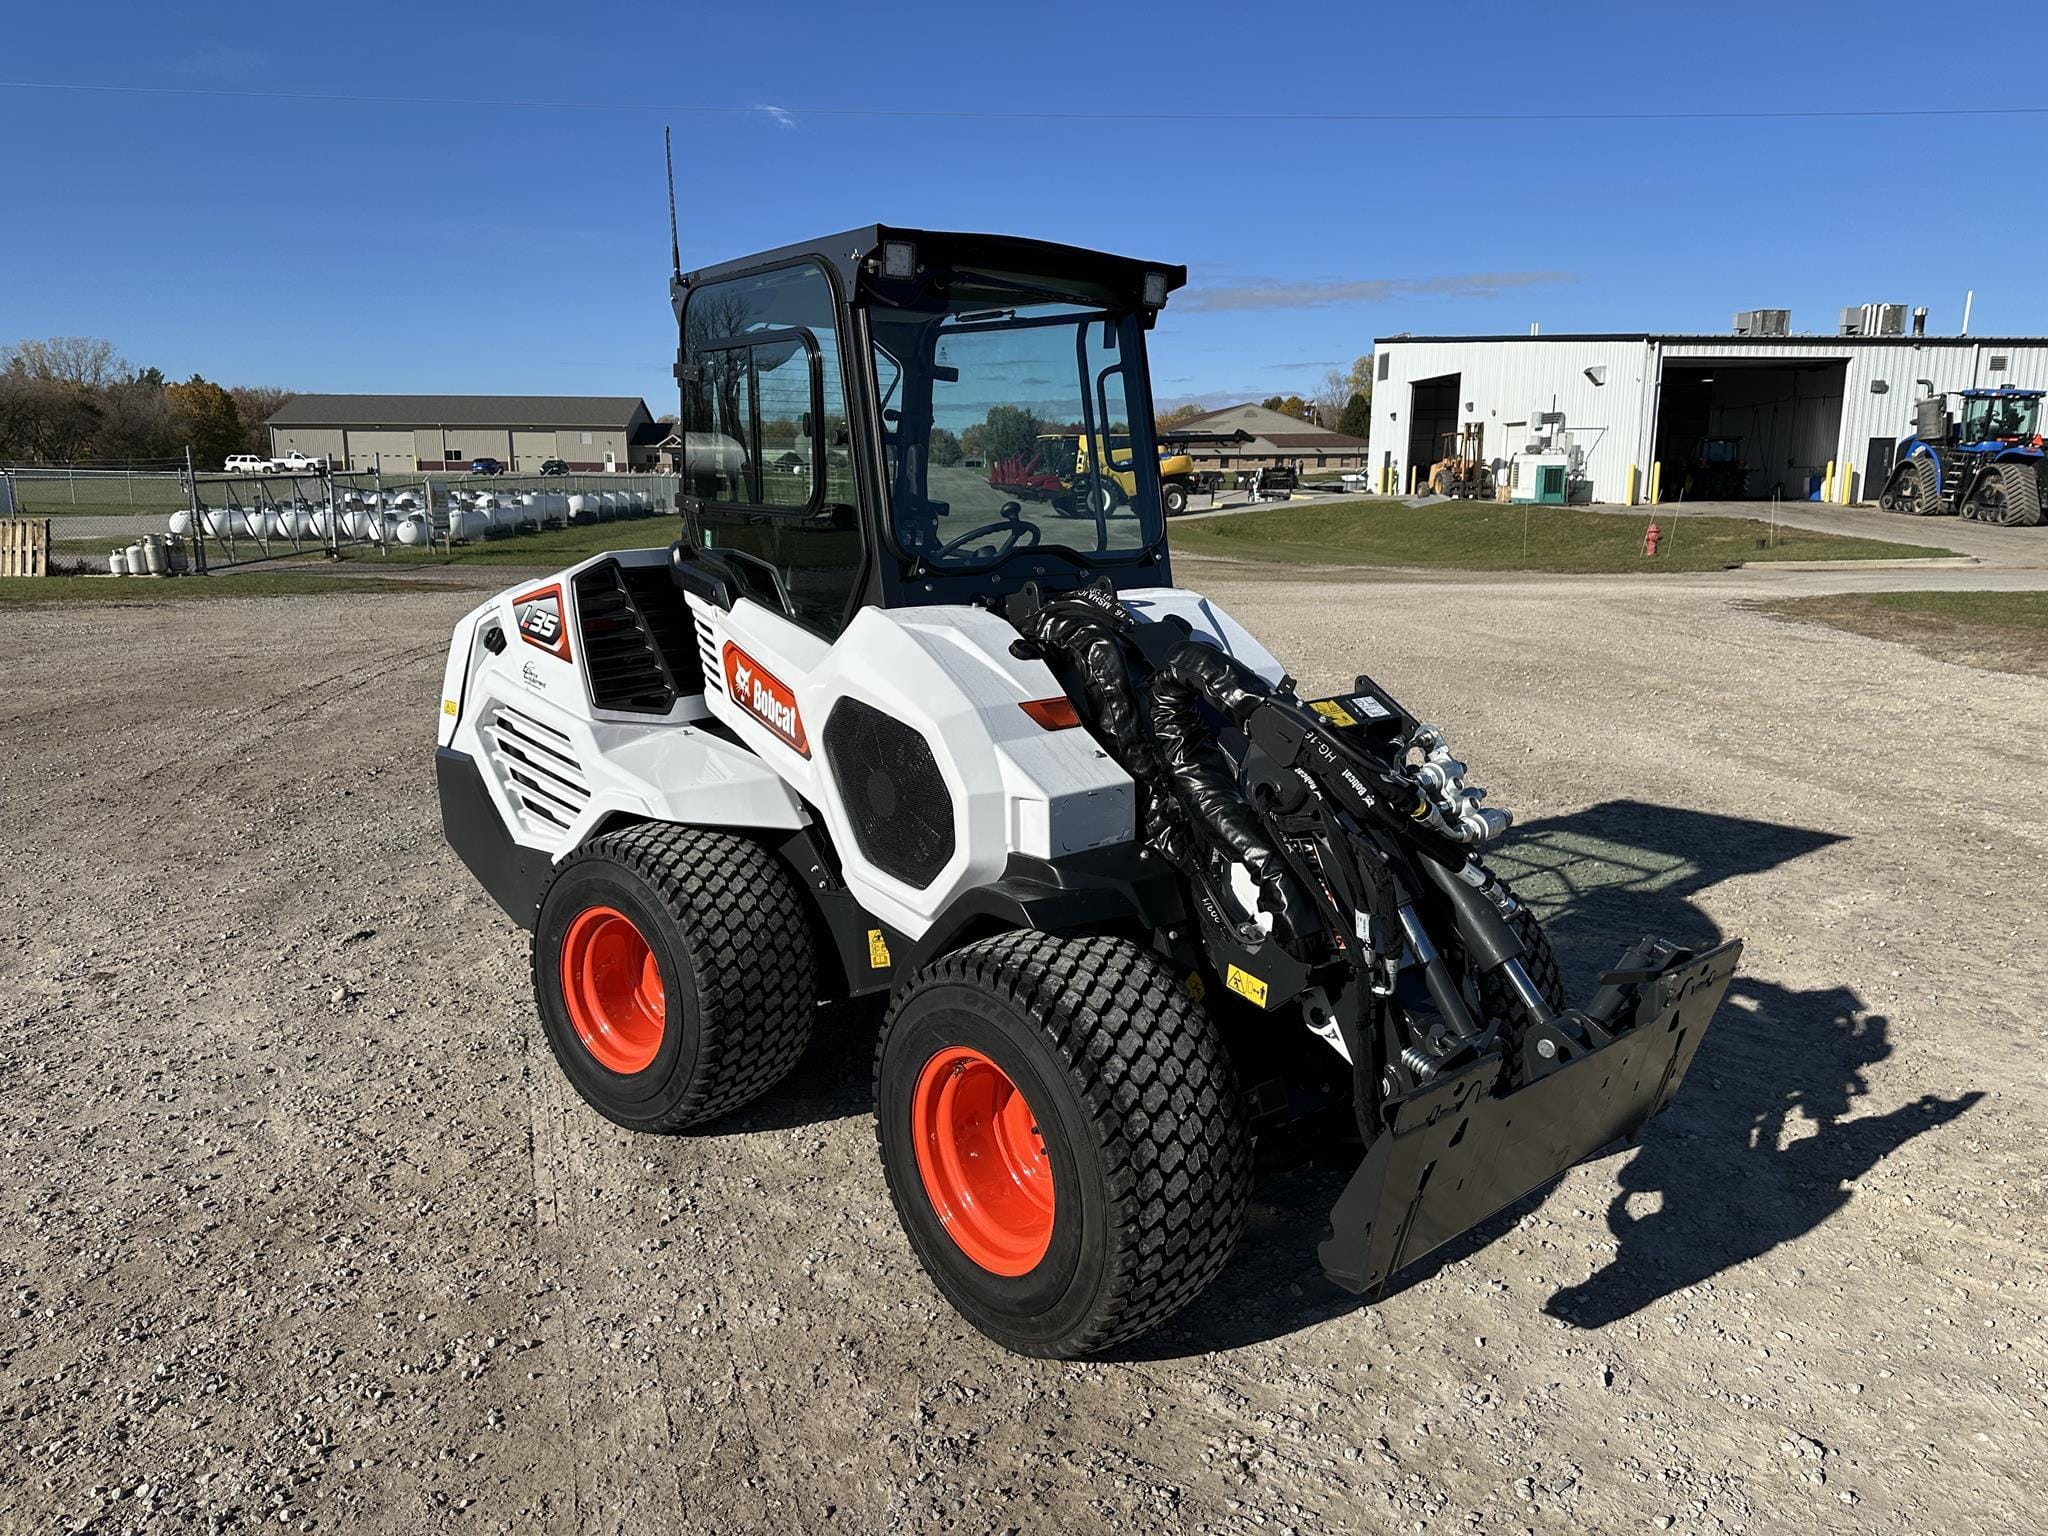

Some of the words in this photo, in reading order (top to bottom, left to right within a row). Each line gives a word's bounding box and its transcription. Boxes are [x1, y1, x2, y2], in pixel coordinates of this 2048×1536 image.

[753, 678, 796, 738] Bobcat
[1294, 767, 1318, 790] Bobcat
[1341, 768, 1367, 797] Bobcat
